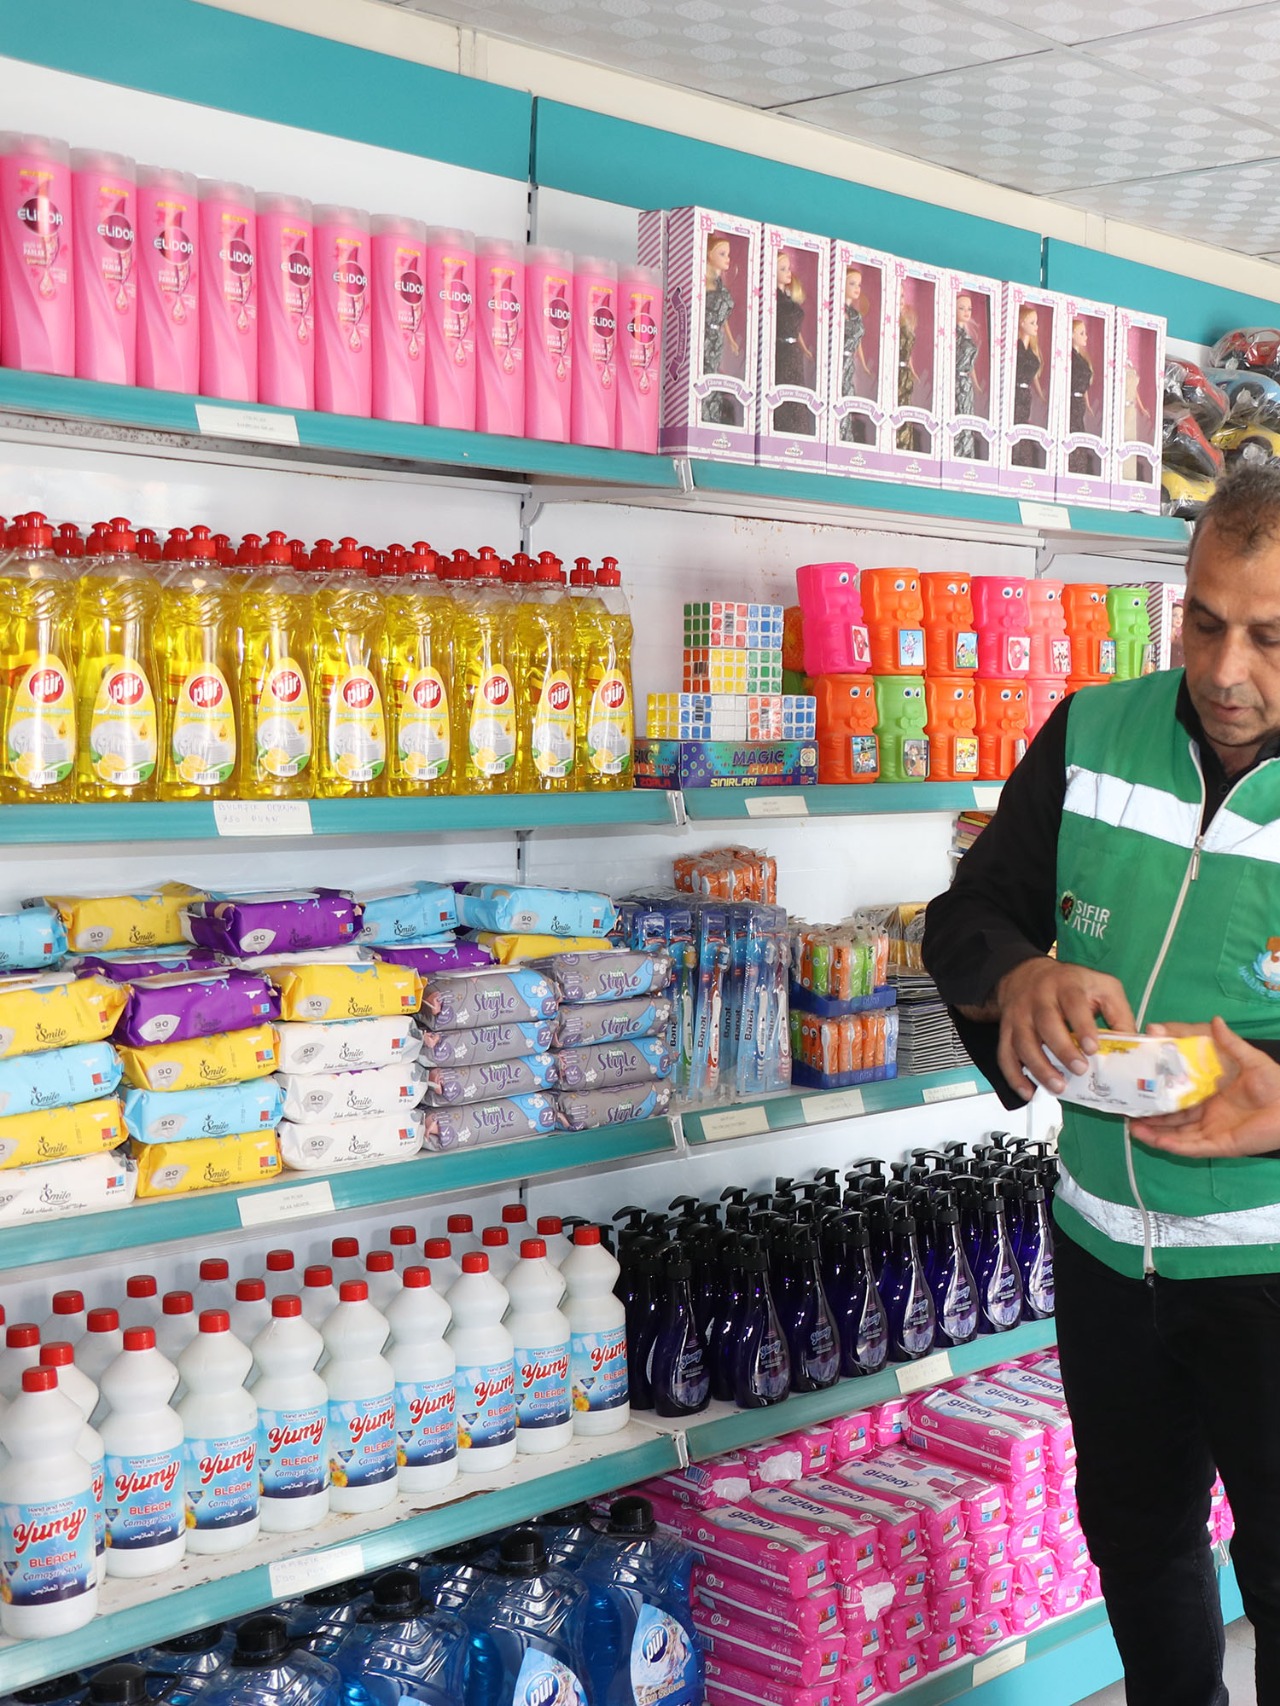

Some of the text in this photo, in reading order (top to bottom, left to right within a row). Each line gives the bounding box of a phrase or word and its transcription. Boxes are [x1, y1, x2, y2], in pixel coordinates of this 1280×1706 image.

[112, 676, 141, 706] pür
[192, 680, 220, 706] pür
[274, 674, 300, 698] pür
[346, 681, 371, 707] pür
[487, 679, 508, 703] pür
[733, 751, 784, 766] MAGIC
[1076, 900, 1110, 923] SIFIR
[1072, 915, 1108, 940] ATIK
[474, 993, 515, 1019] Style
[473, 1108, 515, 1134] Style
[521, 1353, 570, 1388] Yumy
[534, 1388, 566, 1399] BLEACH
[985, 1386, 1035, 1407] gizlady
[947, 1398, 999, 1418] gizlady
[268, 1417, 327, 1453] Yumy
[199, 1443, 257, 1484] Yumy
[281, 1454, 319, 1468] BLEACH
[115, 1461, 180, 1502] Yumy
[214, 1481, 252, 1496] BLEACH
[862, 1468, 915, 1488] gizlady
[130, 1501, 172, 1515] BLEACH
[778, 1494, 830, 1515] gizlady
[13, 1508, 87, 1554] Yumy
[728, 1509, 782, 1531] gizlady
[29, 1551, 77, 1568] BLEACH
[647, 1627, 664, 1667] pür
